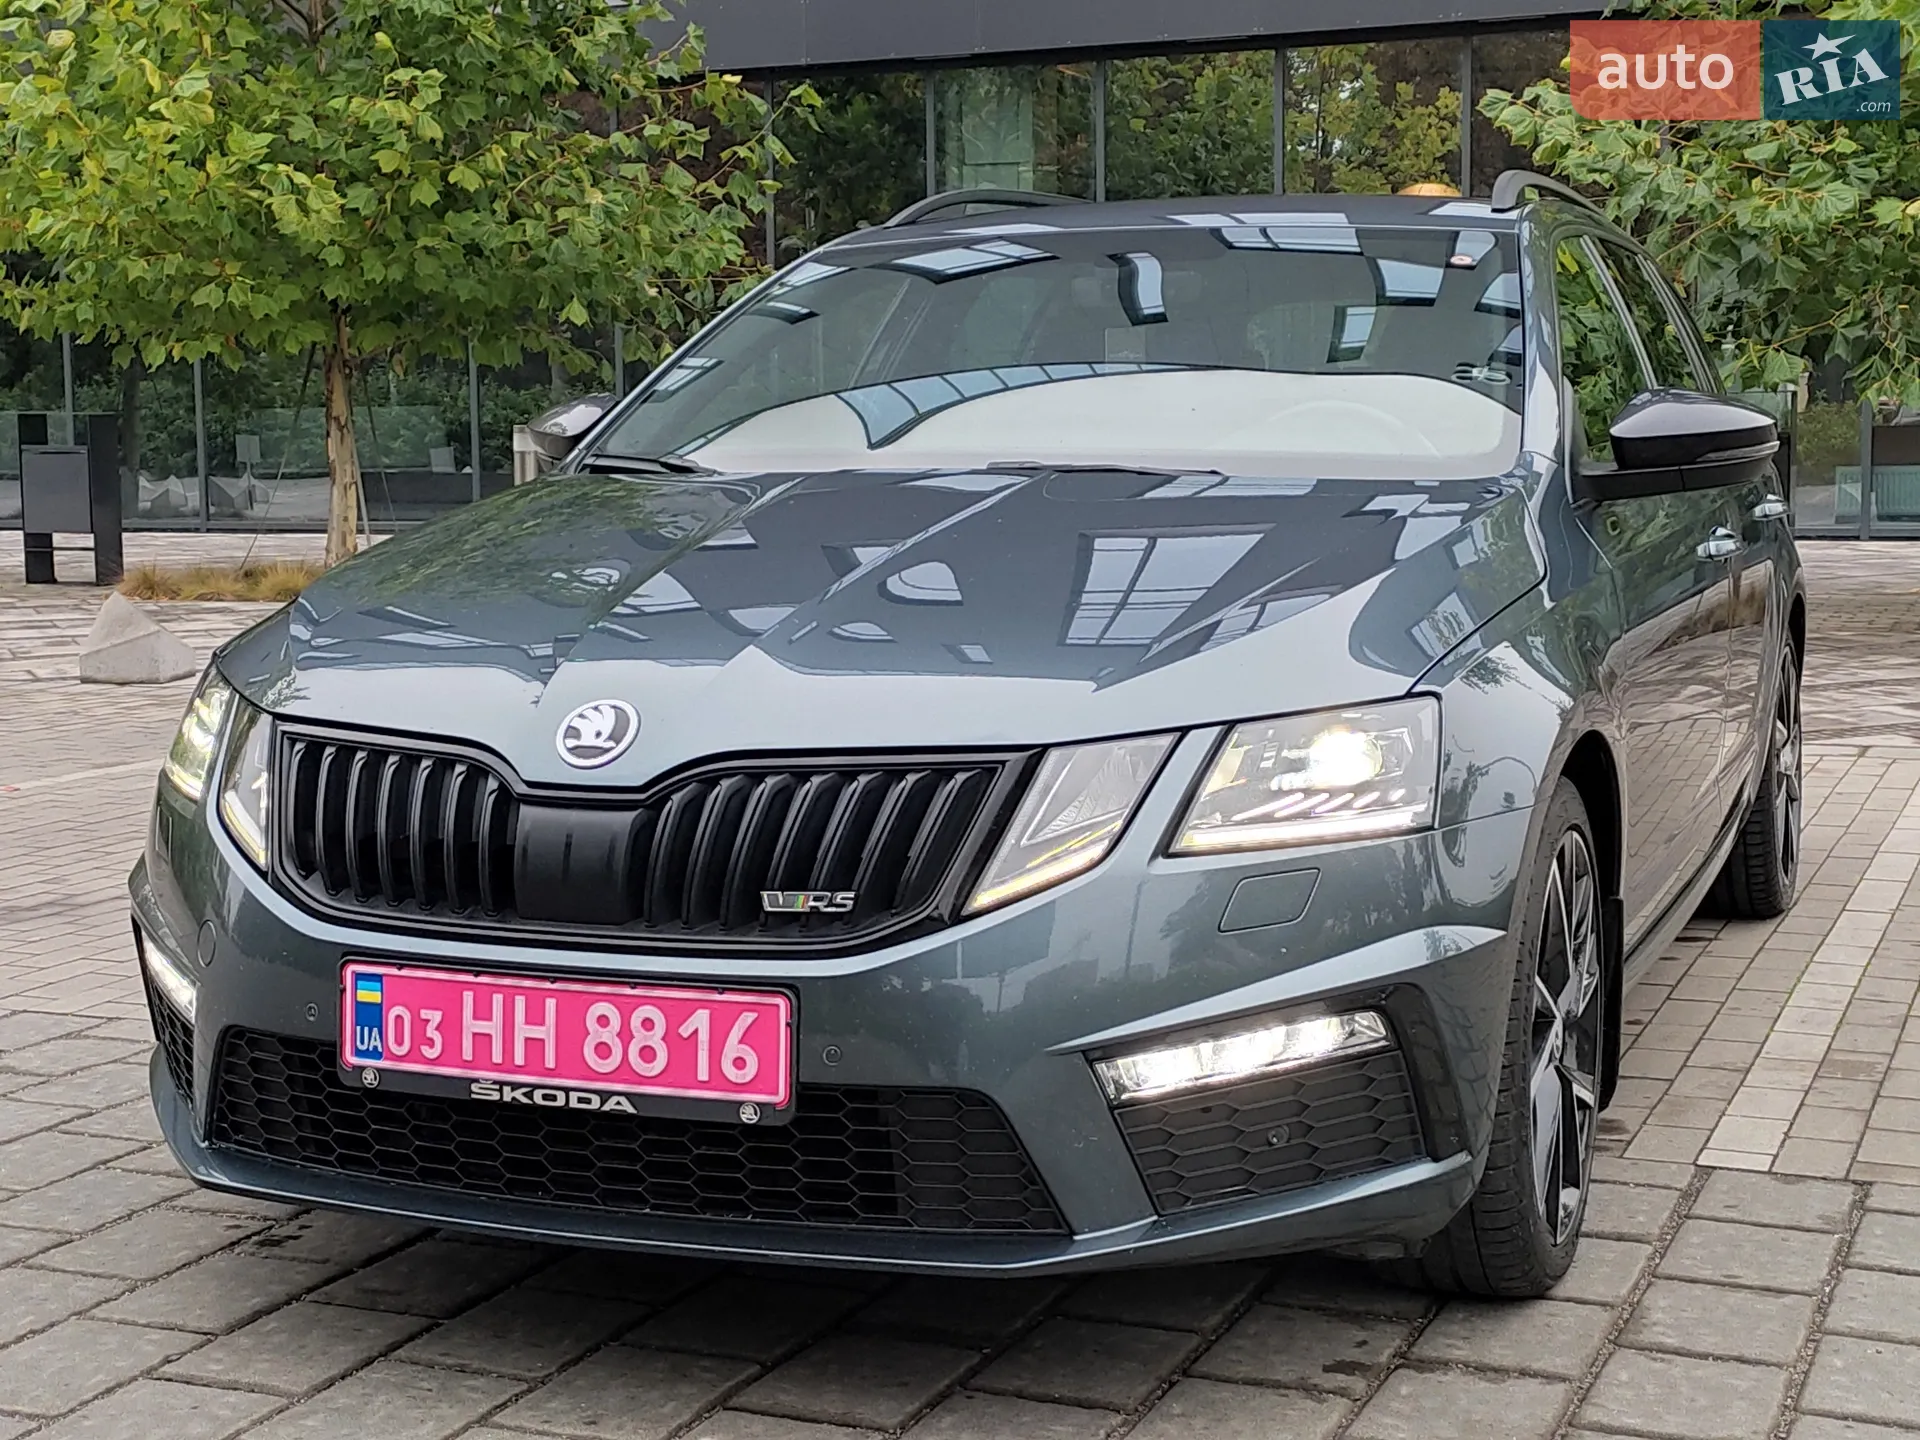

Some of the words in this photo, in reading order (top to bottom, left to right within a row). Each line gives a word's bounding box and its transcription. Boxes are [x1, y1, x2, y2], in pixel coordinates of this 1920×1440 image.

[356, 1025, 383, 1052] UA
[387, 1006, 444, 1060] 03
[462, 990, 557, 1069] HH
[582, 1001, 760, 1085] 8816
[470, 1078, 638, 1113] ŠKODA
